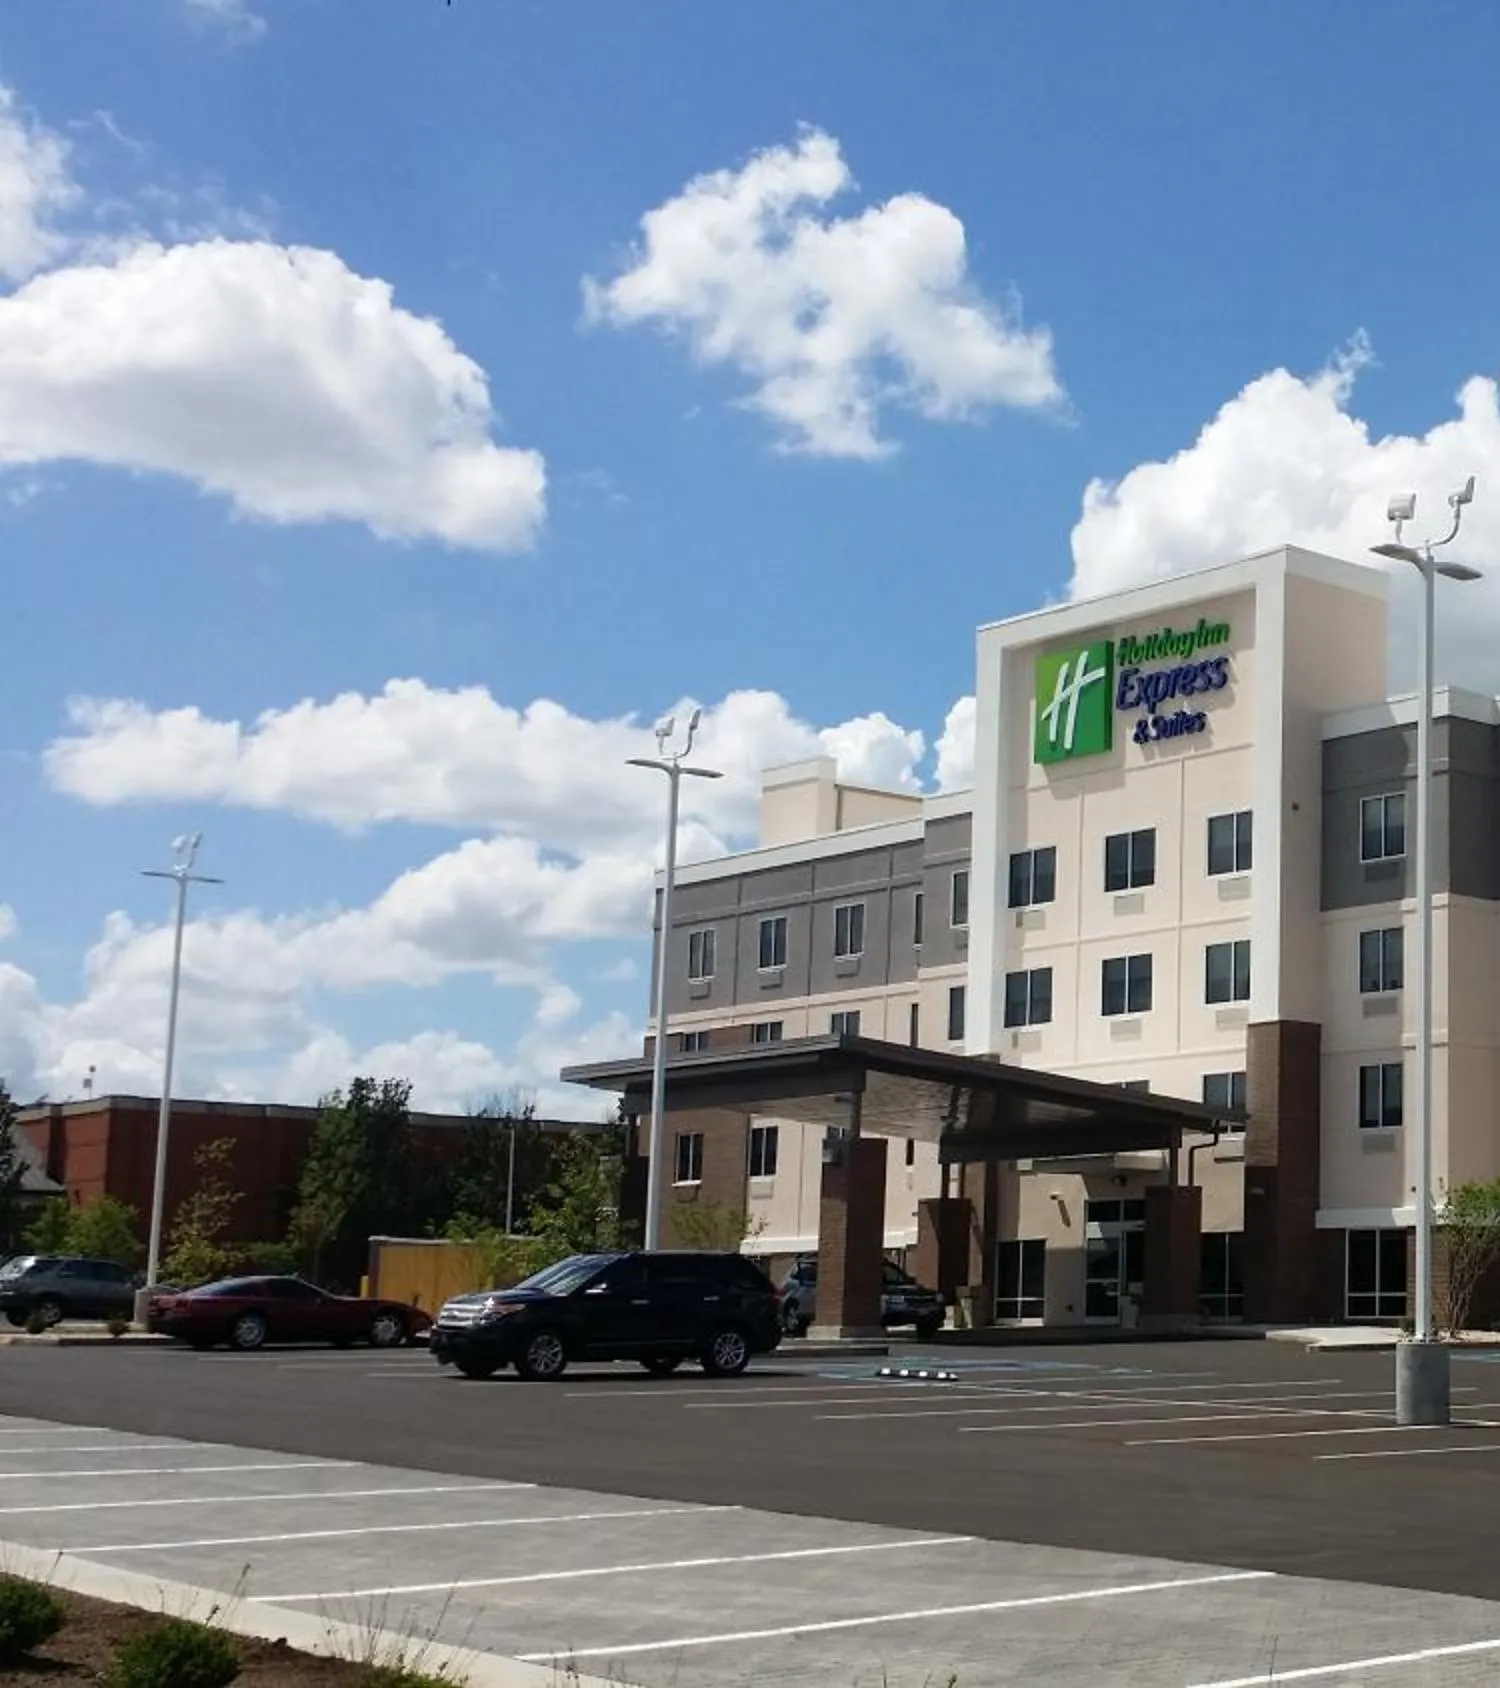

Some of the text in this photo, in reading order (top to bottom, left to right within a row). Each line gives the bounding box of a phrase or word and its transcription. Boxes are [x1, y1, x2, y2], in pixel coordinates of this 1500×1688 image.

[1117, 618, 1230, 667] Holiday Inn
[1116, 656, 1229, 714] Express
[1133, 711, 1207, 745] & Suites
